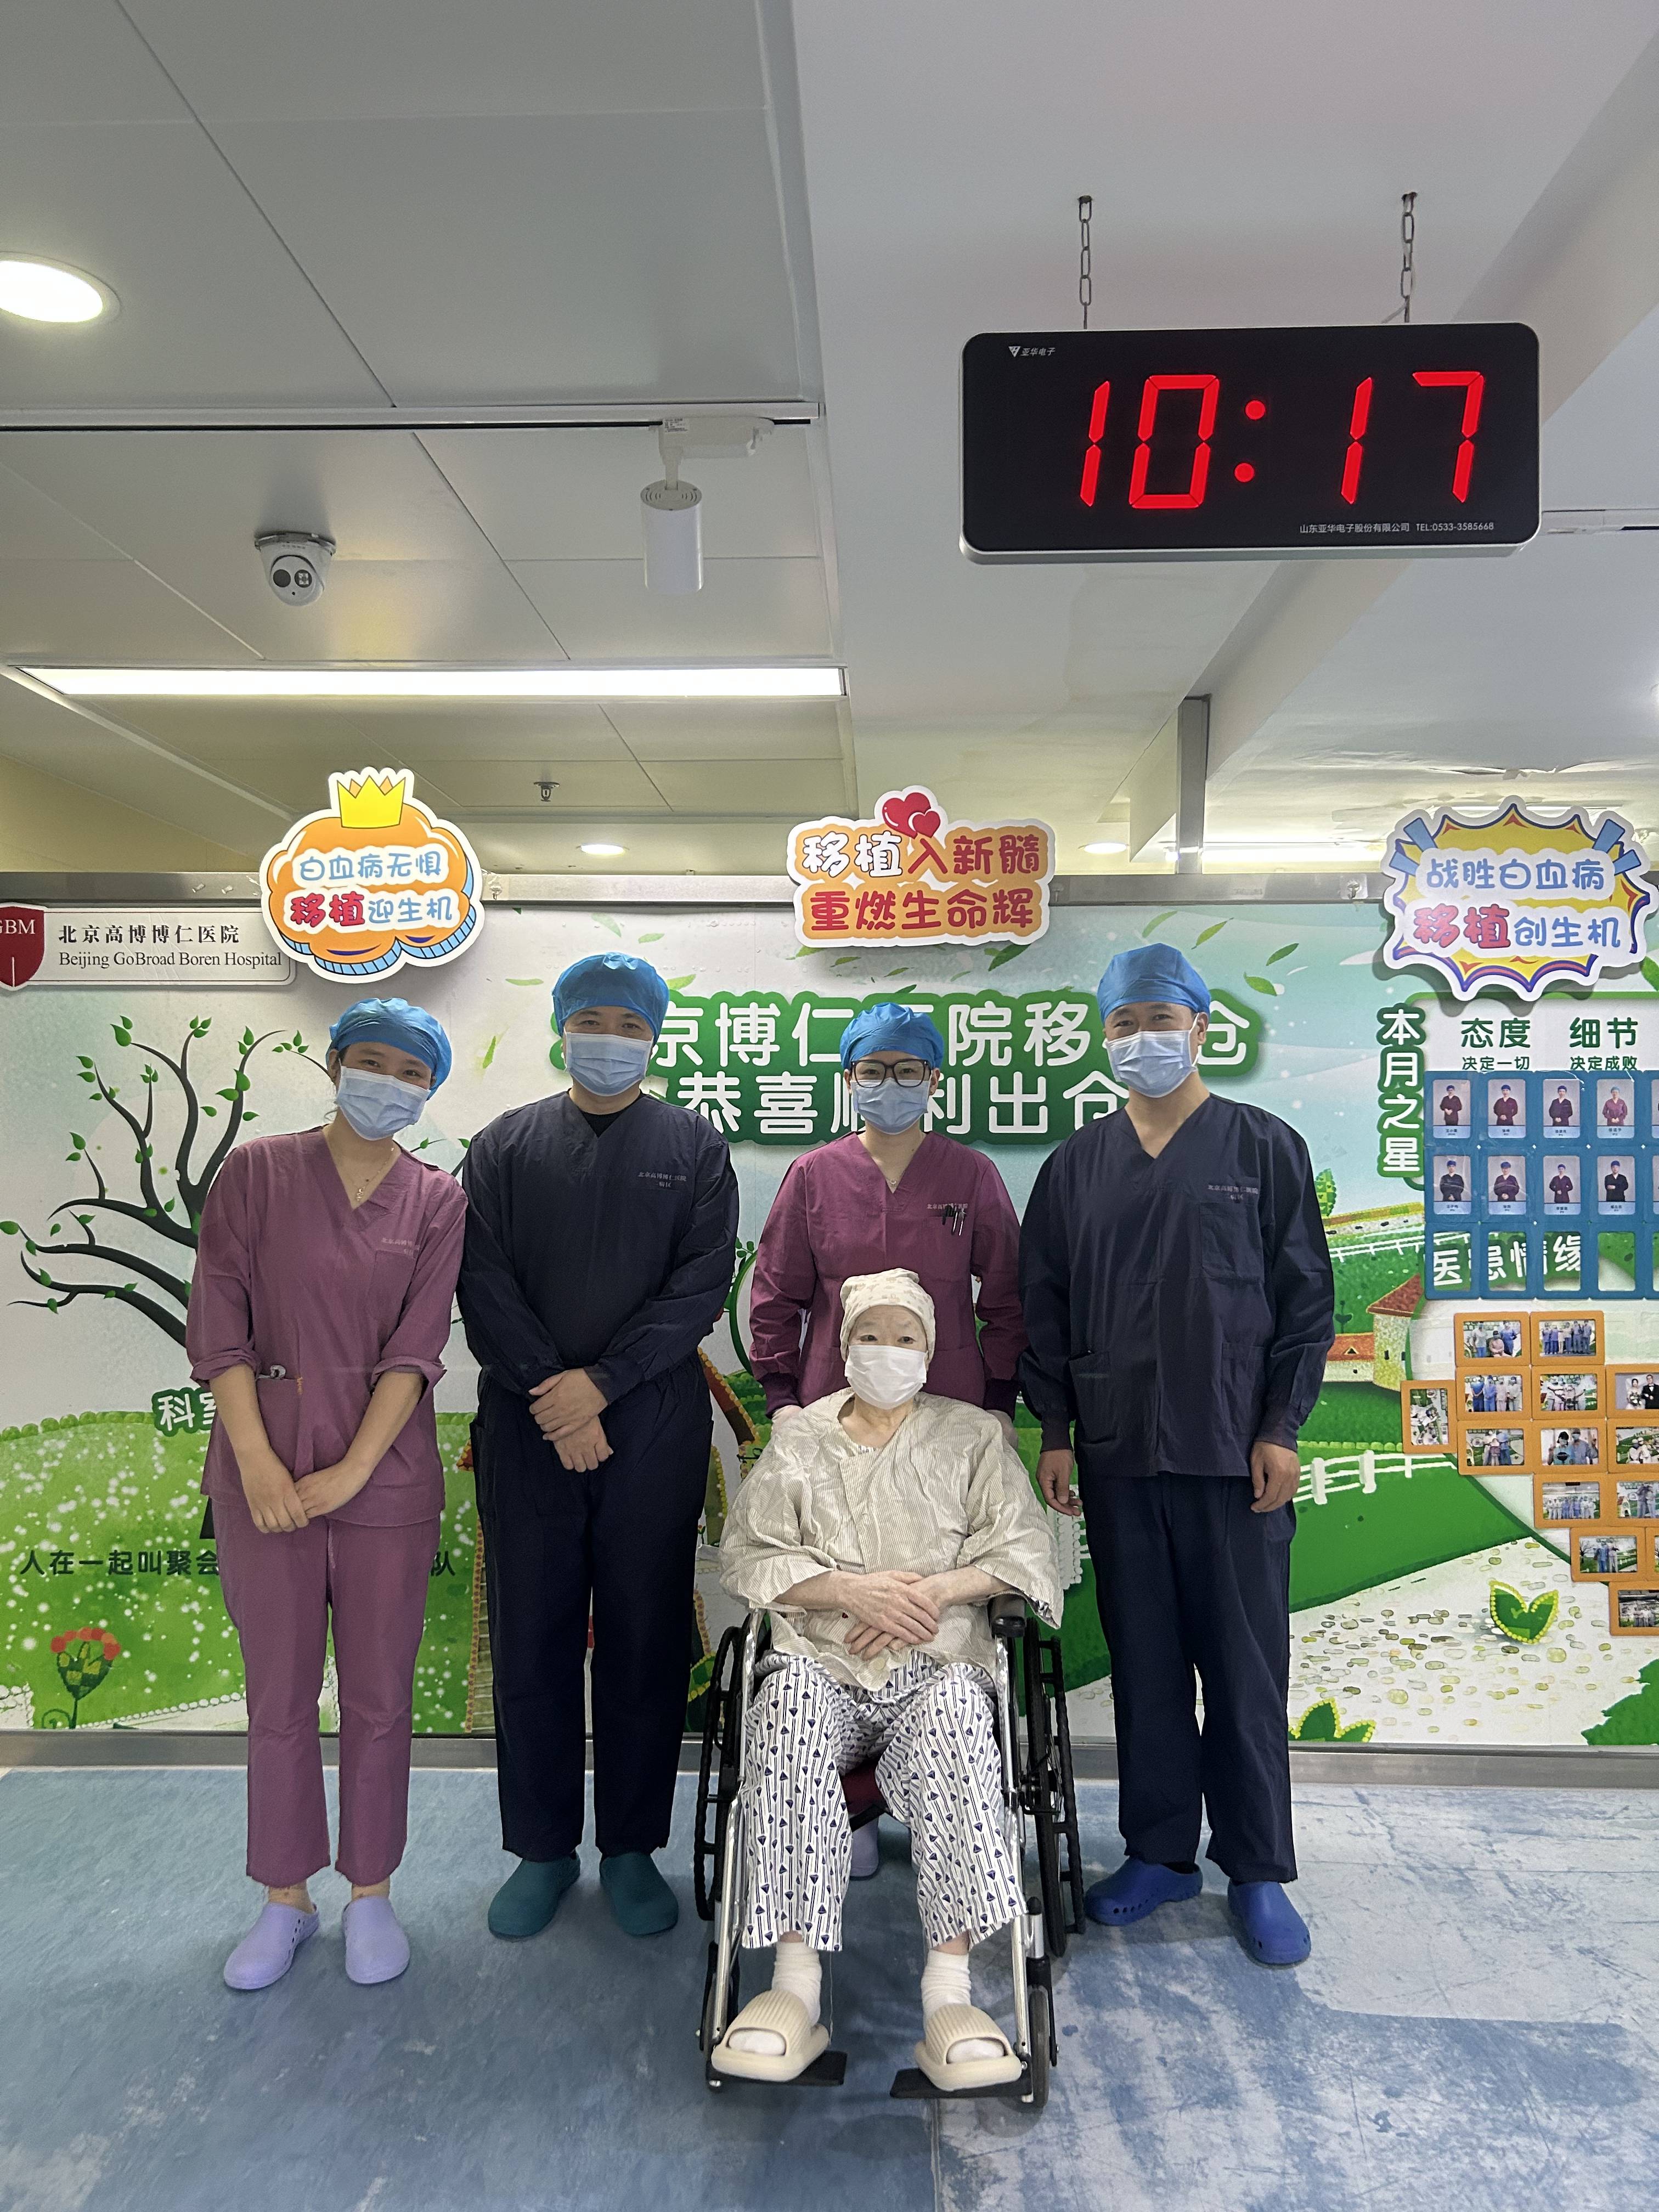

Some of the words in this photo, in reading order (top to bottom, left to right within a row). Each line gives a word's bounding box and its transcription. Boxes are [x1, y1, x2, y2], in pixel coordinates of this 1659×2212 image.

[1020, 347, 1056, 356] 亚华电子
[1080, 371, 1484, 509] 10:17
[1300, 523, 1409, 533] 山东亚华电子股份有限公司
[1416, 522, 1494, 532] TEL:0533-3585668
[300, 850, 442, 881] 白血病无惧
[802, 830, 1040, 878] 移植入新髓
[1426, 858, 1605, 890] 战胜白血病
[290, 891, 453, 928] 移植迎生机
[810, 888, 1034, 930] 重燃生命辉
[59, 924, 240, 944] 北京高博博仁医院
[1413, 903, 1621, 949] 移植创生机
[59, 952, 110, 969] Beijing
[179, 952, 220, 966] Boren
[225, 952, 281, 969] Hospital
[561, 1001, 1250, 1067] 京博仁院移仓
[1461, 1018, 1531, 1049] 态度
[1569, 1017, 1638, 1049] 细节
[1462, 1056, 1530, 1070] 决定一切
[1570, 1056, 1638, 1071] 决定成败
[1383, 1008, 1420, 1172] 本月之星
[20, 1549, 220, 1576] 人在一起叫聚会
